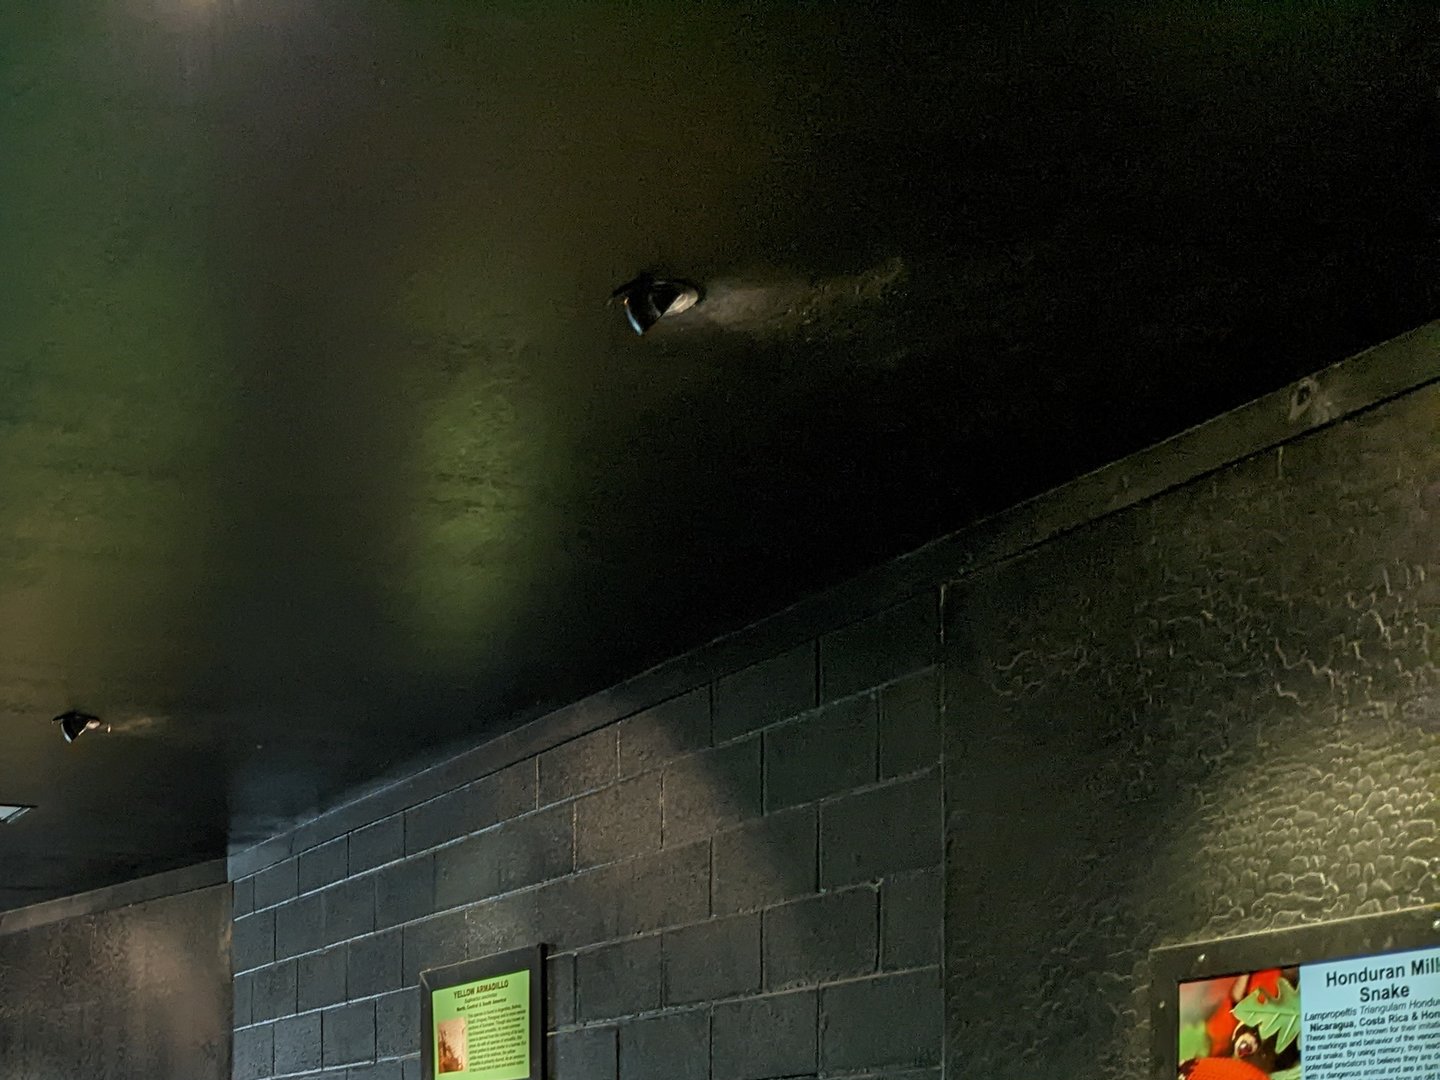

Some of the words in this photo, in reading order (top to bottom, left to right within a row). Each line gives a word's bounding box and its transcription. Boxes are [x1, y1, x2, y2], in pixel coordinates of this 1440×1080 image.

[1326, 966, 1405, 987] Honduran
[454, 988, 474, 999] YELLOW
[477, 980, 508, 993] ARMADILLO
[1360, 984, 1409, 1002] Snake
[1310, 1021, 1356, 1032] Nicaragua,
[1359, 1017, 1385, 1027] Costa
[1388, 1014, 1408, 1023] Rica
[1411, 1012, 1418, 1021] &
